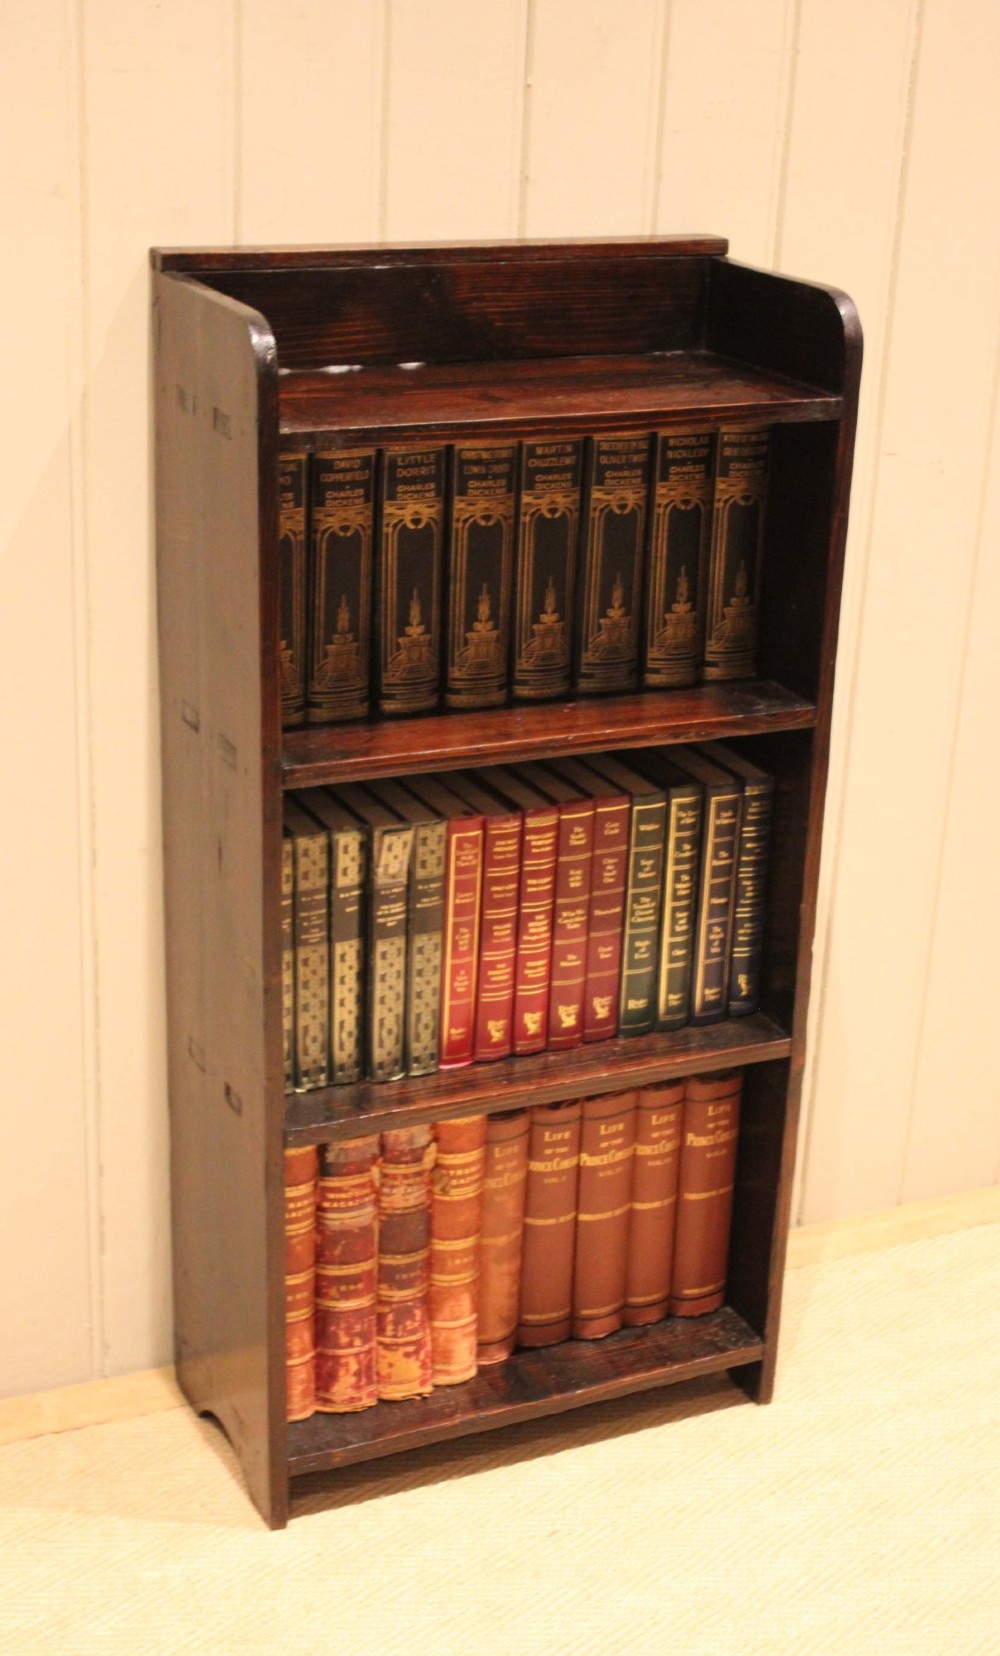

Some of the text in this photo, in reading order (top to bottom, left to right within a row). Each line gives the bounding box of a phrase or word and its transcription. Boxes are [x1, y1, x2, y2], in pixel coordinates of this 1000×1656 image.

[535, 444, 573, 456] MARTIN
[397, 453, 436, 466] LITTLE
[396, 465, 437, 478] DORRIT
[605, 469, 643, 479] CHARLES
[669, 464, 706, 474] CHARLES
[535, 472, 573, 482] CHARLES
[397, 482, 436, 493] CHARLES
[467, 479, 507, 489] CHARLES
[535, 481, 573, 490] DICKENS
[605, 478, 643, 487] DICKENS
[396, 491, 436, 501] DICKENS
[467, 487, 507, 497] DICKENS
[651, 1113, 676, 1126] LIFE
[599, 1122, 625, 1135] LIFE
[543, 1130, 571, 1142] LIFE
